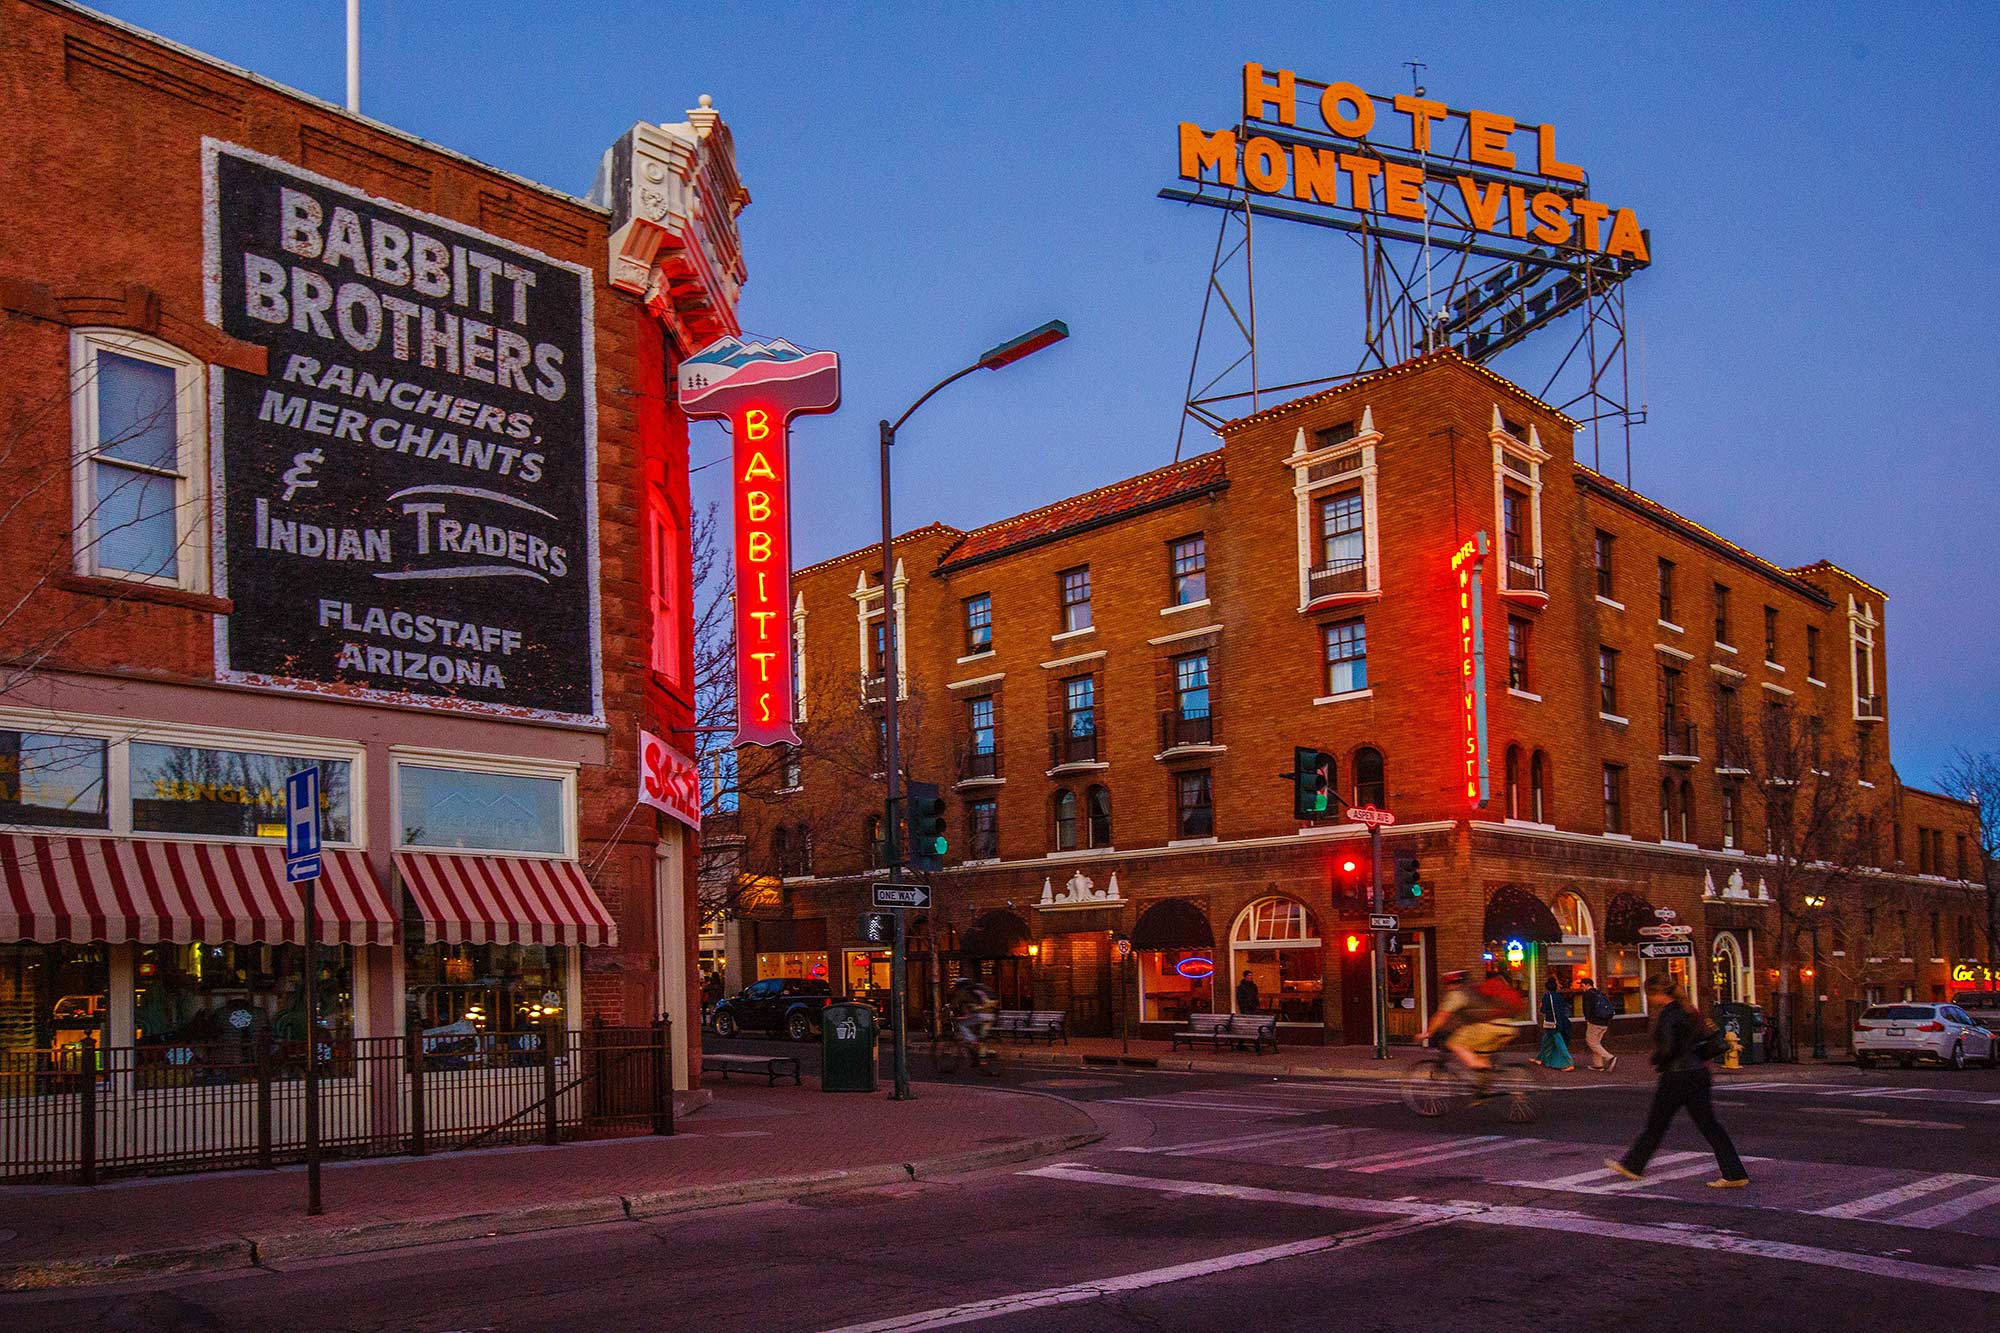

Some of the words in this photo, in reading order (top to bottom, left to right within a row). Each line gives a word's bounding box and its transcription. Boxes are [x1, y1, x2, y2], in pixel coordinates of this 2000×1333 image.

[1244, 61, 1585, 183] HOTEL
[1178, 122, 1427, 220] MONTE
[1456, 175, 1650, 264] VISTA
[280, 186, 537, 326] BABBITT
[244, 252, 567, 402] BROTHERS
[258, 389, 546, 483] MERCHANTS
[282, 353, 543, 445] RANCHERS,
[282, 448, 326, 501] &
[255, 497, 392, 563] INDIAN
[402, 502, 568, 578] TRADERS
[744, 408, 779, 723] BABBITTS
[1451, 540, 1476, 571] HOTEL
[318, 598, 522, 655] FLAGSTAFF
[338, 642, 506, 690] ARIZONA
[1459, 569, 1472, 676] MONTE
[1464, 693, 1477, 798] VISTA
[290, 773, 317, 855] H
[1353, 809, 1375, 820] ASPEN
[1376, 812, 1390, 823] AVE
[879, 890, 897, 900] ONE
[899, 891, 916, 900] WAY
